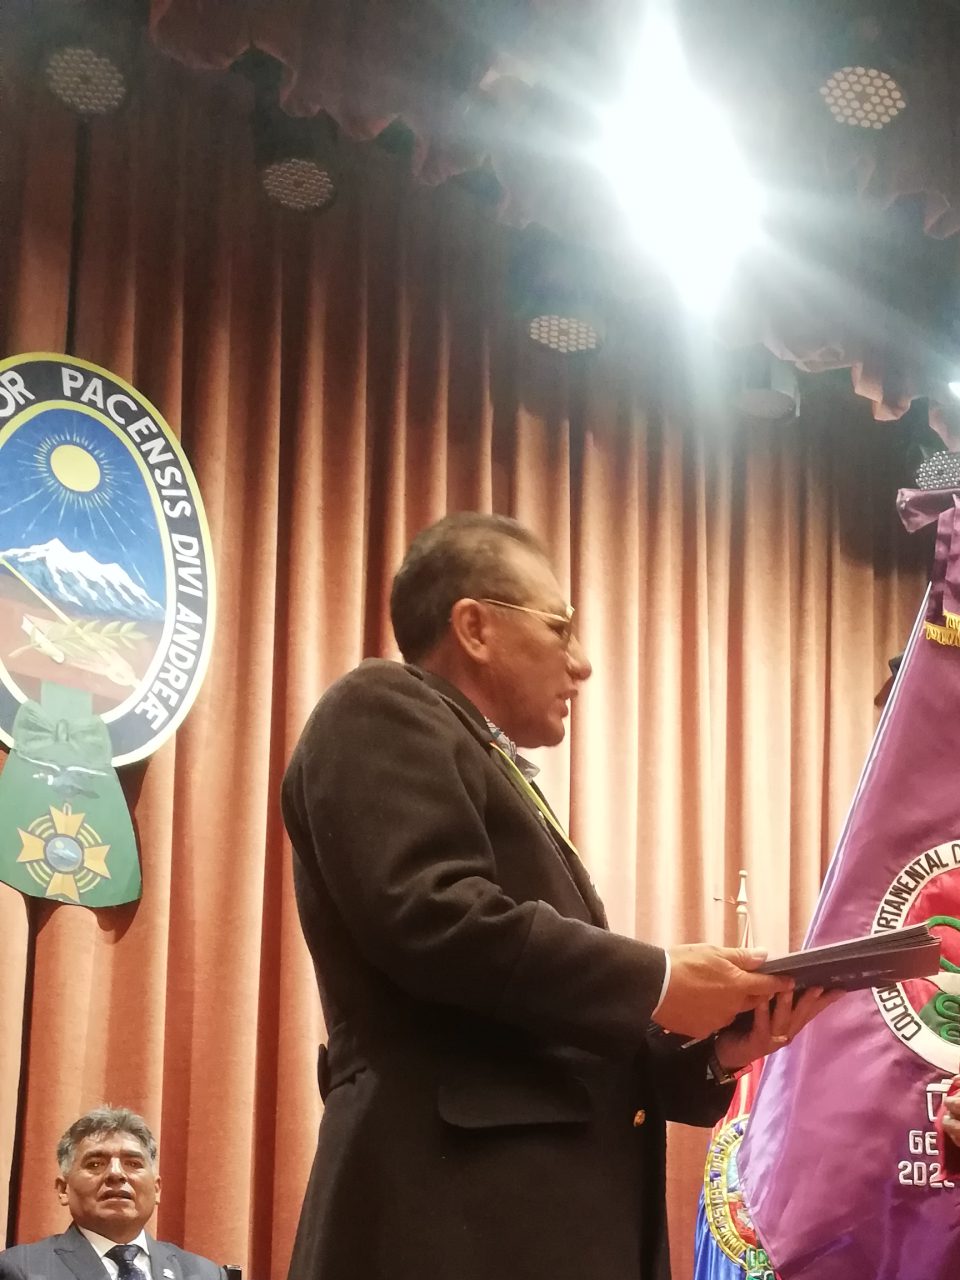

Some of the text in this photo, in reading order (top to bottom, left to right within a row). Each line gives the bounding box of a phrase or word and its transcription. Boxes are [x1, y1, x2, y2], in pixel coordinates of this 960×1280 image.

[61, 366, 192, 519] PACENSIS
[171, 533, 203, 598] DIVI
[874, 850, 949, 934] RTAMENTAL
